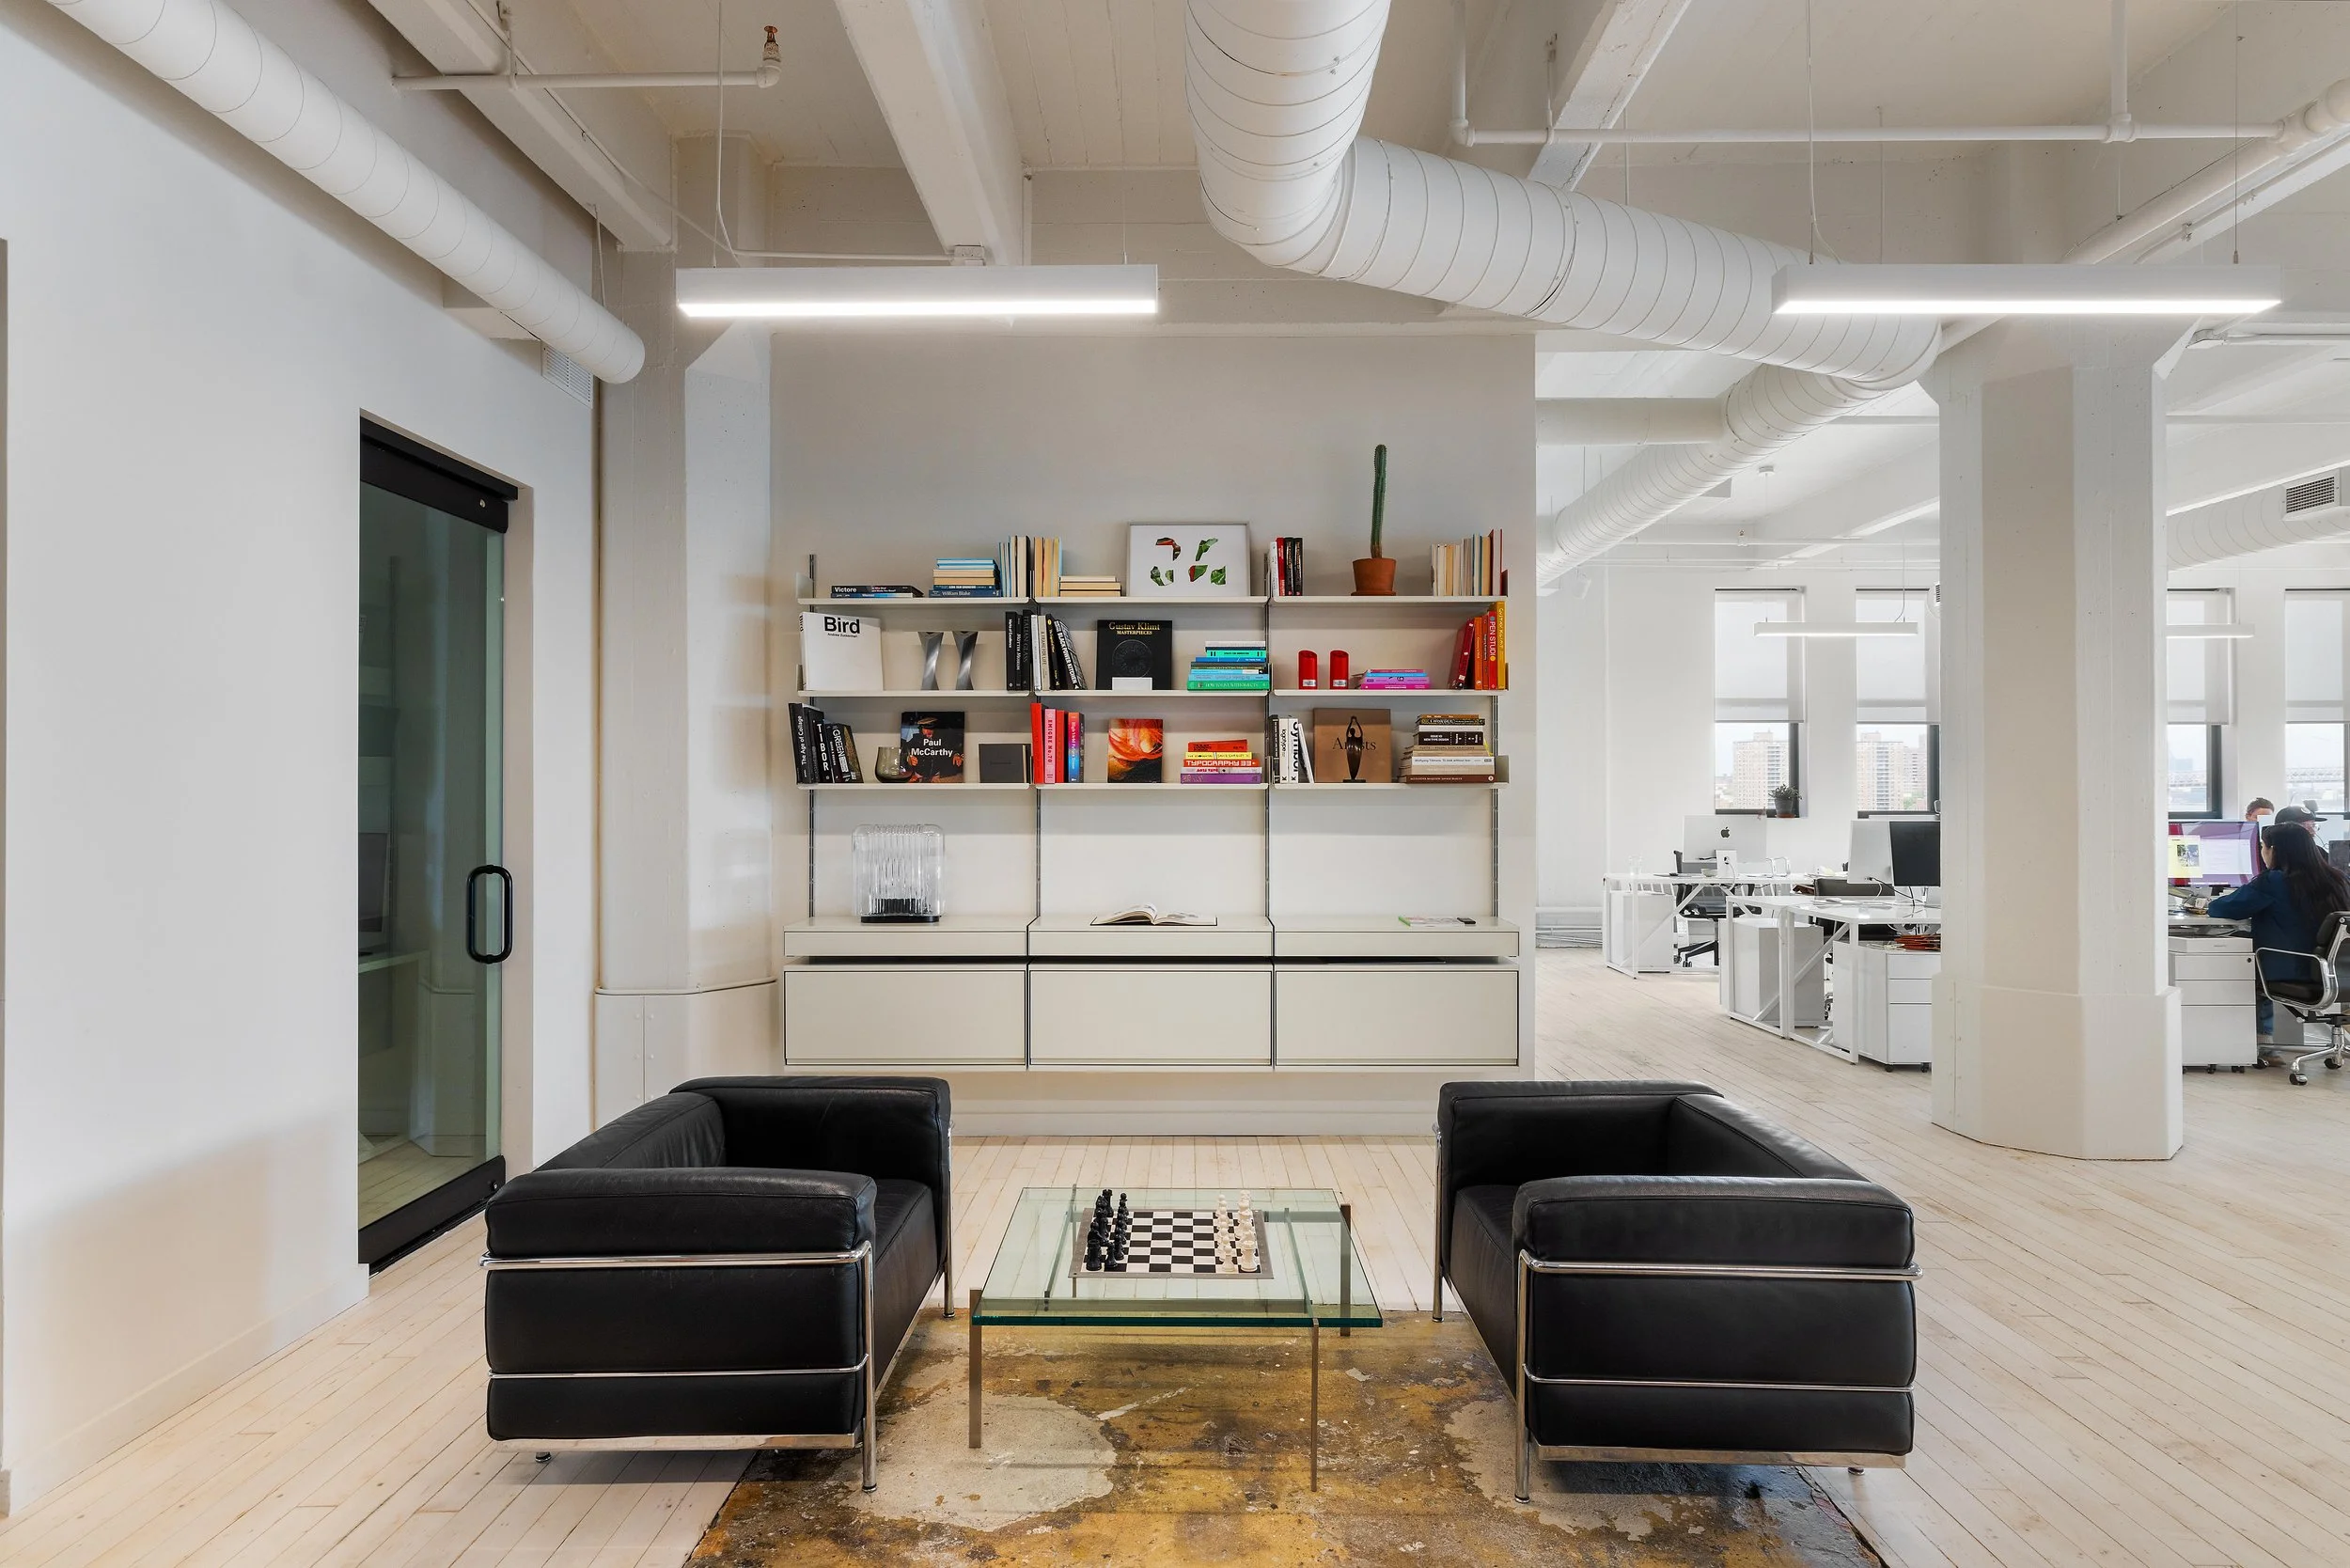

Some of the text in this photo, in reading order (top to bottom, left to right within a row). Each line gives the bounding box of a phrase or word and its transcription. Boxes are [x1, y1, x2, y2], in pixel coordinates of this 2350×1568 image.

[824, 616, 860, 635] Bird
[1109, 621, 1136, 630] Gustav
[1058, 632, 1067, 648] BLACK
[1062, 647, 1072, 664] POWER
[1067, 663, 1077, 684] KITCHEN
[817, 723, 829, 771] TIBOR
[923, 738, 942, 746] Paul
[1332, 737, 1376, 750] Arts
[911, 747, 953, 758] McCarthy
